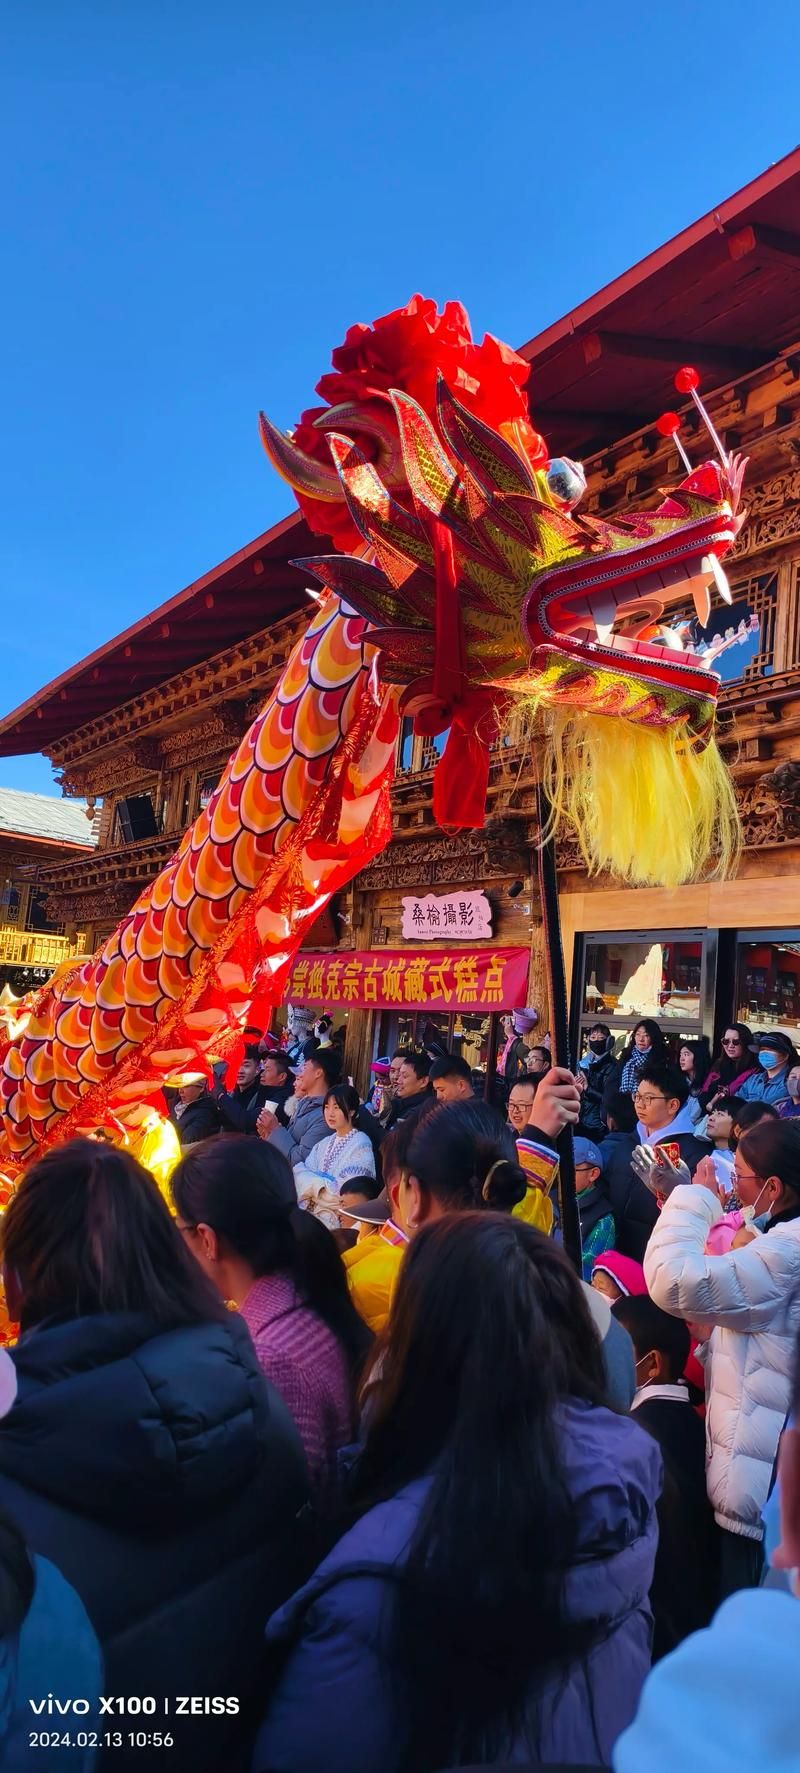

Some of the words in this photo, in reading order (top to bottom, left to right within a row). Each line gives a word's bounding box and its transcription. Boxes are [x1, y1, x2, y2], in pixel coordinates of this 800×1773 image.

[412, 902, 474, 926] 桑榆攝影
[283, 954, 507, 1003] 尝独克宗古城藏式糕点
